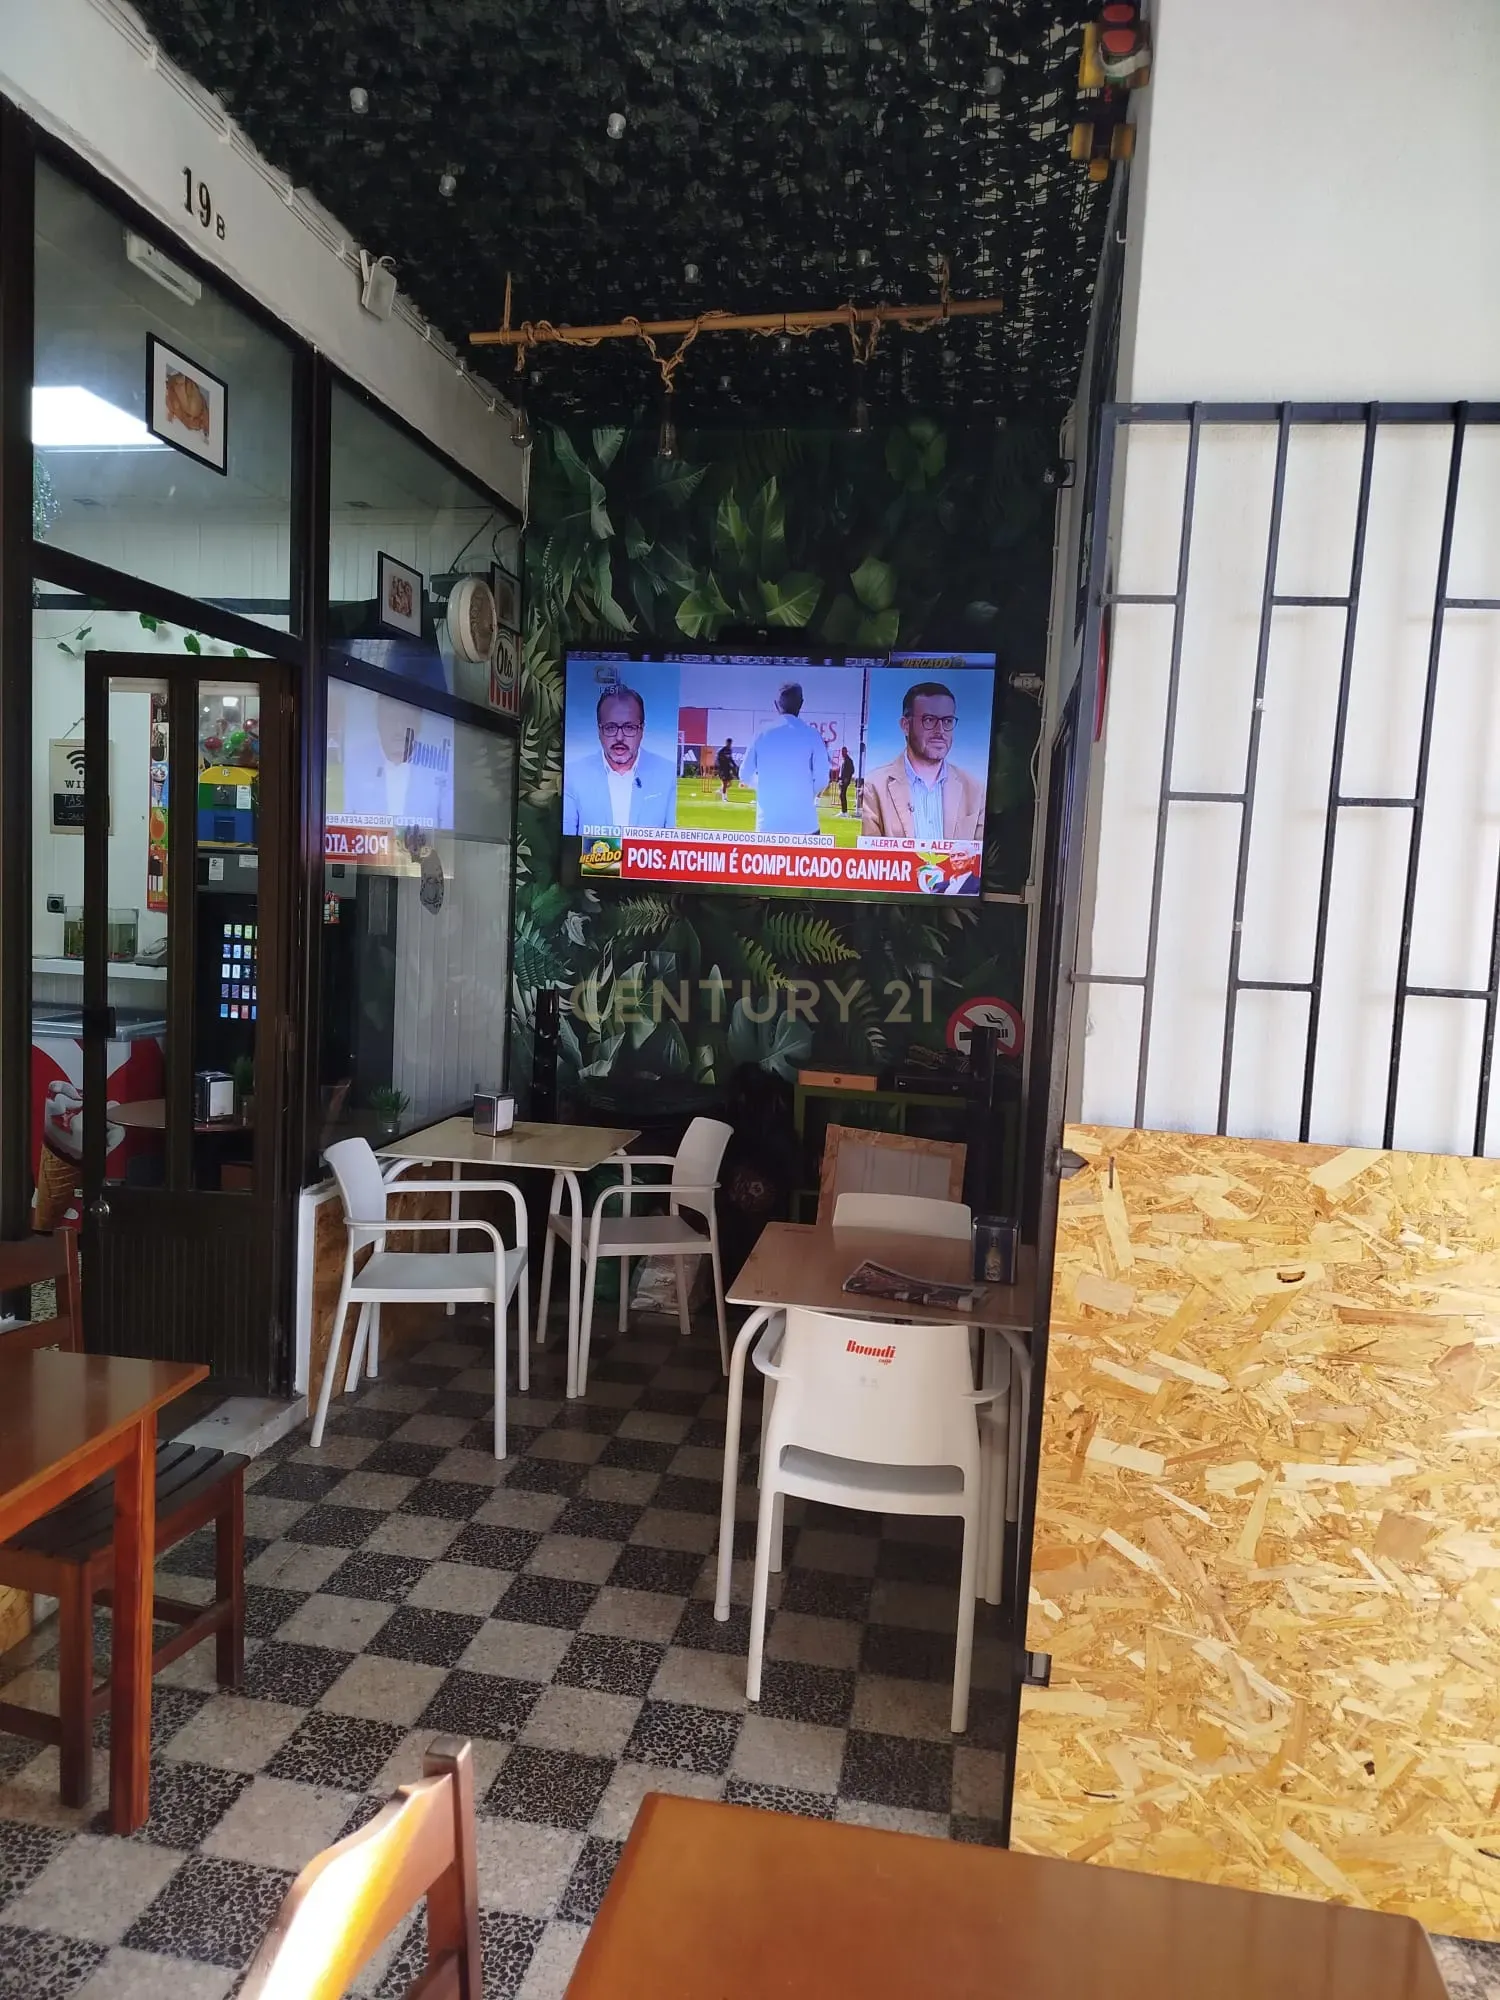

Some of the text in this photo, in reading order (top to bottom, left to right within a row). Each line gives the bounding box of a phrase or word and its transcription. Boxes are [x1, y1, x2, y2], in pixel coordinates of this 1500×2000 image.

[182, 166, 225, 241] 19 B
[64, 780, 84, 788] WI
[582, 824, 621, 837] DIRETO
[625, 828, 833, 846] VIROSE AFETA BENFICA A POUCOS DIAS DO CLÁSSICO
[871, 839, 899, 849] ALERTA
[579, 850, 622, 864] MERCADO
[627, 847, 912, 882] POIS: ATCHIM É COMPLICADO GANHAR
[846, 1340, 896, 1359] Buondi
